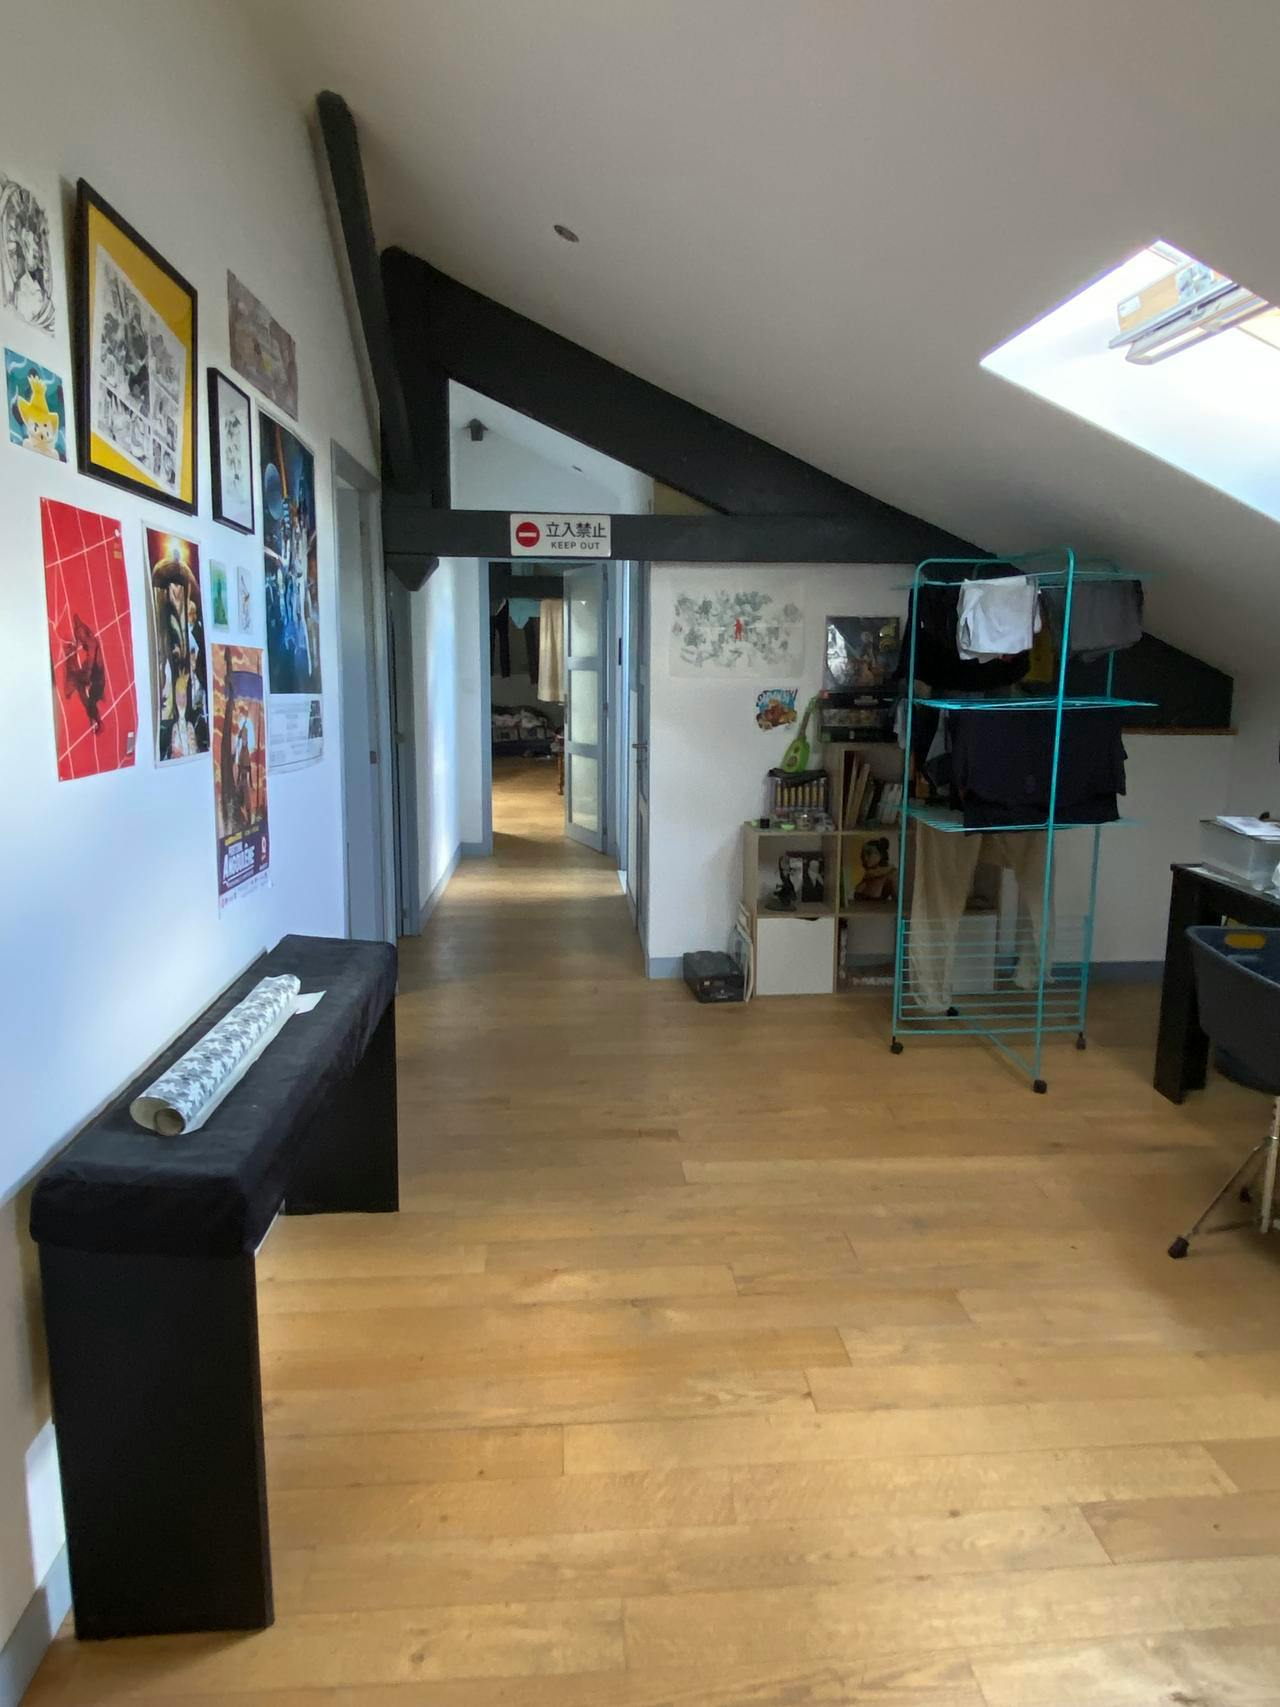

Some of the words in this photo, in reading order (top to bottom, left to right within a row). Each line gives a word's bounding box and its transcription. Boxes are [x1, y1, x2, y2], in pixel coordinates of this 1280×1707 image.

[545, 521, 607, 538] 立入禁止
[551, 541, 576, 550] KEEP
[580, 541, 600, 550] OUT
